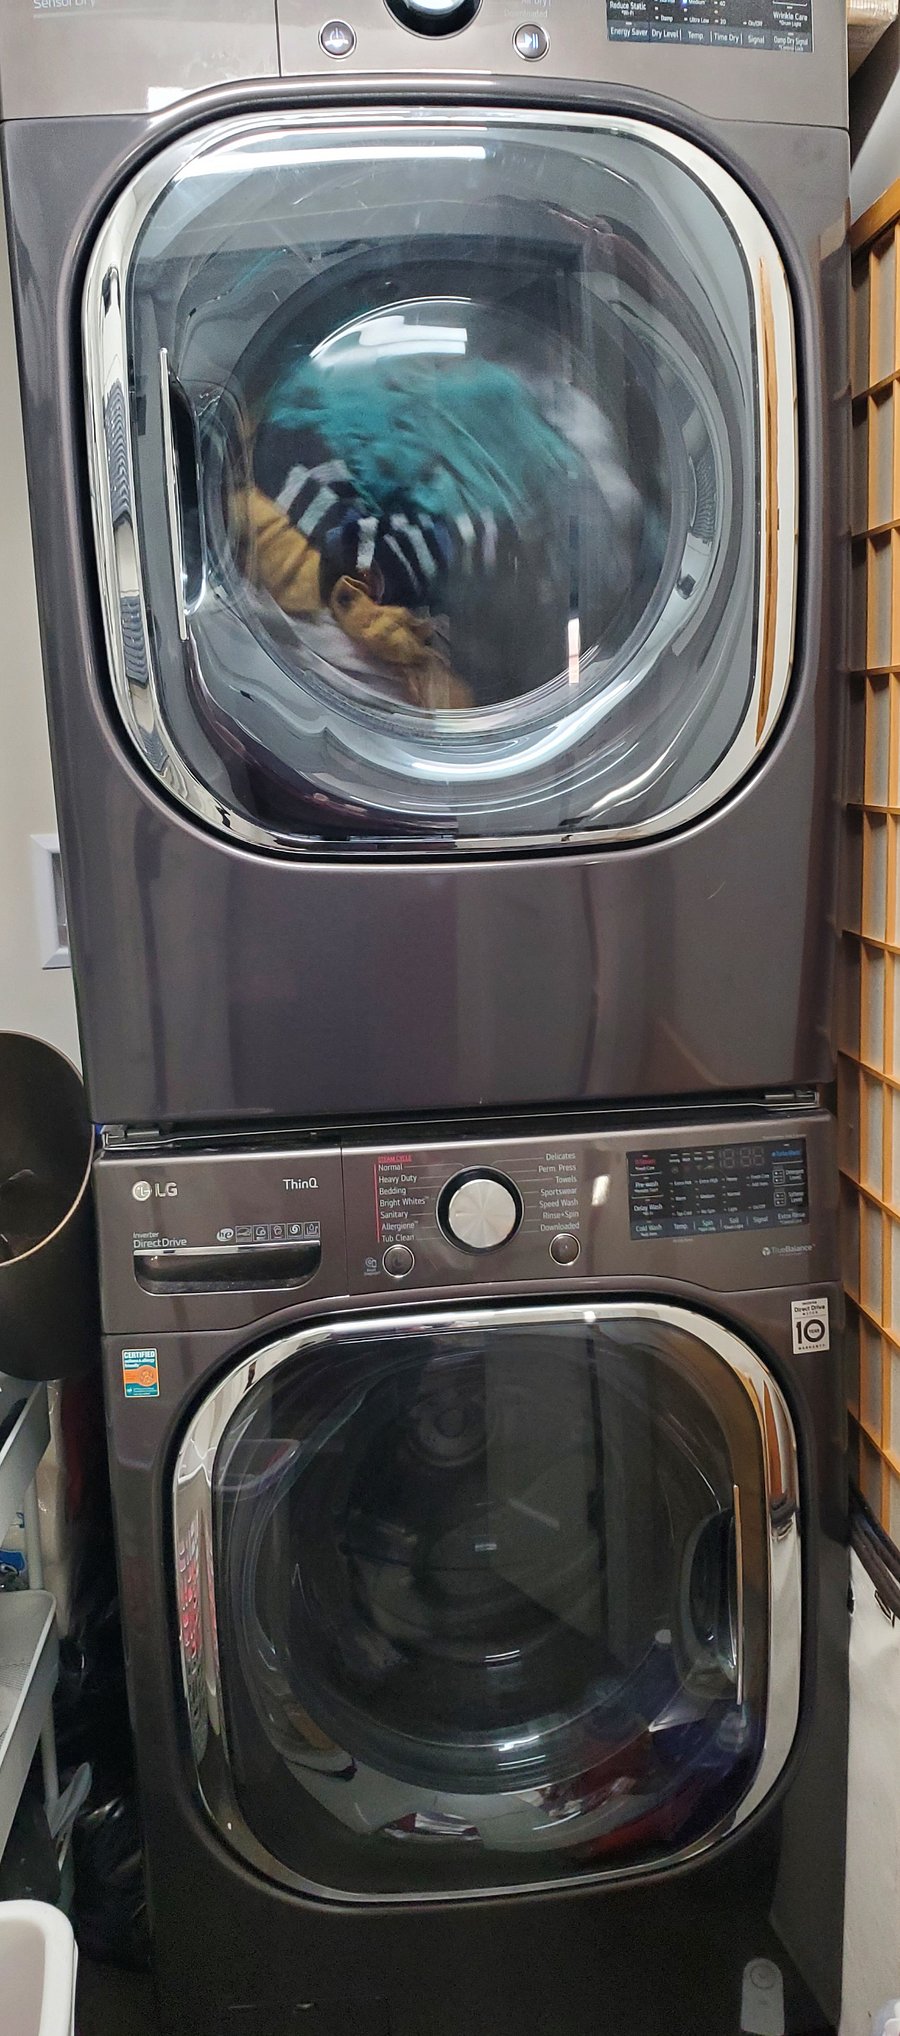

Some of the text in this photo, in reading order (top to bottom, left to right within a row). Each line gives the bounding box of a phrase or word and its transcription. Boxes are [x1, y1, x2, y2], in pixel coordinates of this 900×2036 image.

[610, 1, 646, 10] Reduce Static
[660, 14, 674, 22] Damp
[773, 11, 808, 22] Wrinkle Care
[611, 26, 648, 38] Energy Saver
[652, 28, 679, 39] Dry Level
[714, 32, 739, 44] Time Dry
[747, 34, 765, 45] Signal
[545, 1152, 576, 1161] Delicates
[378, 1163, 403, 1172] Normal
[558, 1163, 577, 1172] Press
[283, 1177, 319, 1190] ThinQ
[379, 1174, 417, 1184] Heavy Duty
[555, 1175, 577, 1184] Towels
[155, 1182, 178, 1197] LG
[379, 1186, 407, 1196] Bedding
[540, 1188, 577, 1198] Sportswear
[379, 1199, 401, 1208] Bright
[539, 1198, 579, 1209] Speed Wash
[380, 1211, 409, 1220] Sanitary
[540, 1221, 580, 1231] Downloaded
[635, 1223, 663, 1232] Cold Wash
[132, 1231, 160, 1239] Inverter
[382, 1233, 415, 1242] Tub Clean
[796, 1319, 825, 1344] 10
